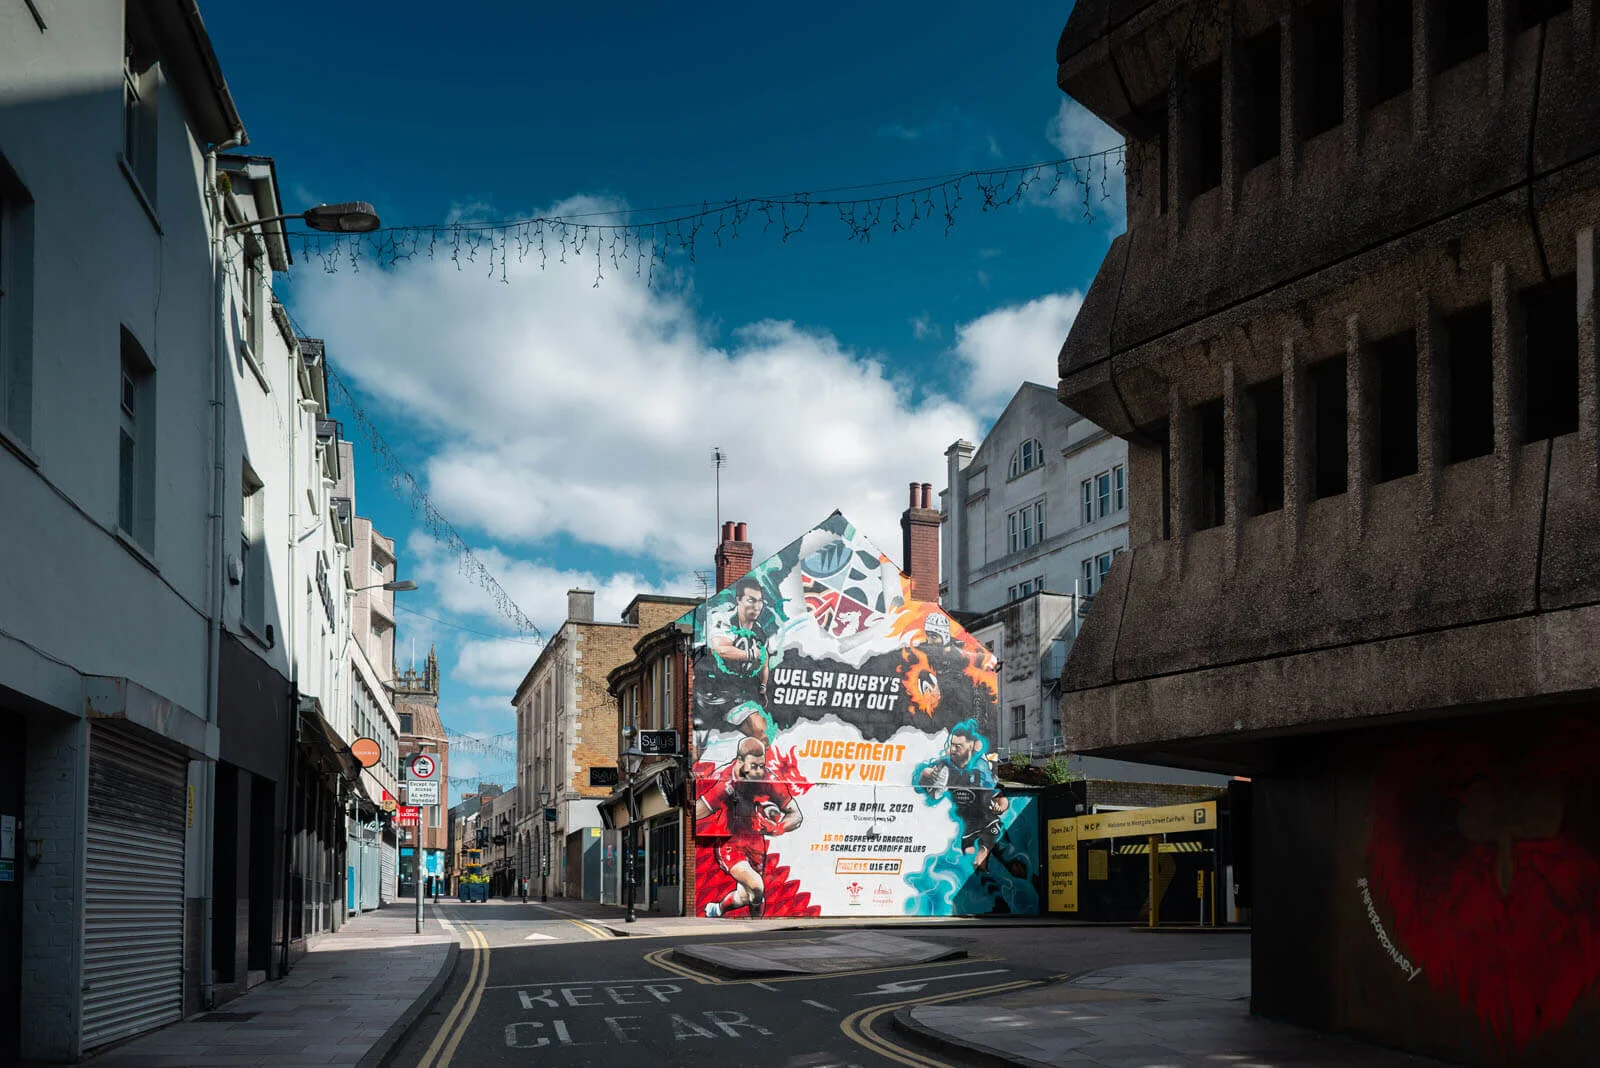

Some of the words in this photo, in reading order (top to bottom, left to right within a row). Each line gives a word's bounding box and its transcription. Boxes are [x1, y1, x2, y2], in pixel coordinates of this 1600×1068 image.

[773, 668, 834, 689] WELSH
[836, 673, 901, 693] RUGBY'S
[773, 687, 828, 706] SUPER
[831, 691, 864, 709] DAY
[866, 693, 899, 711] OUT
[798, 739, 906, 762] JUDGEMENT
[820, 761, 856, 780] DAY
[859, 763, 887, 782] VIII
[823, 801, 842, 812] SAT
[844, 802, 857, 812] 18
[859, 802, 886, 812] APRIL
[889, 803, 914, 813] 2020
[830, 844, 866, 852] SCARLETS
[873, 844, 901, 853] CARDIFF
[904, 845, 927, 853] BLUES
[882, 835, 914, 844] DRAGONS
[869, 863, 883, 871] U16
[884, 863, 899, 871] £10
[517, 983, 683, 1009] KEEP
[504, 1010, 776, 1048] CLEAR
